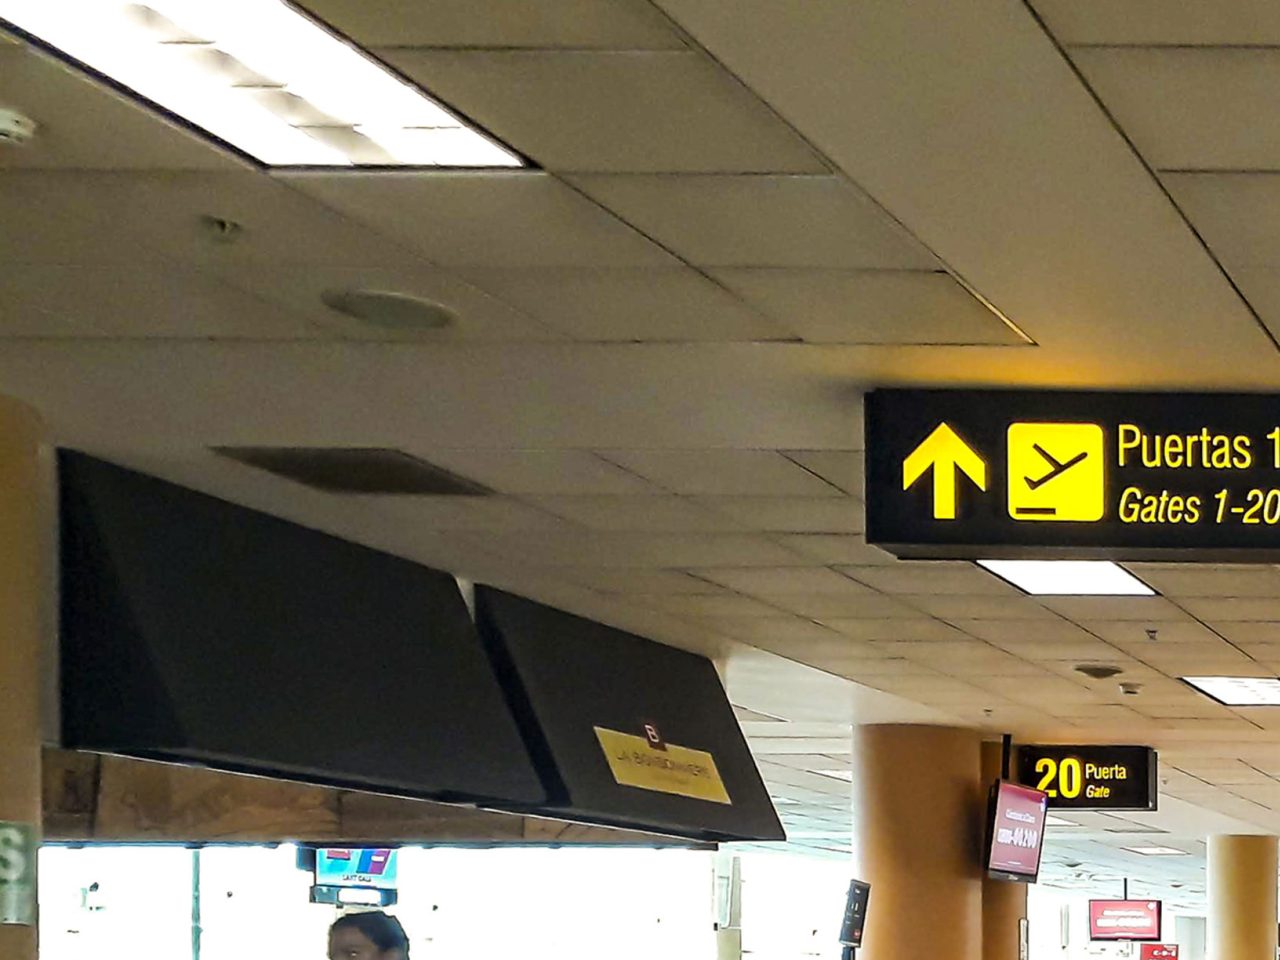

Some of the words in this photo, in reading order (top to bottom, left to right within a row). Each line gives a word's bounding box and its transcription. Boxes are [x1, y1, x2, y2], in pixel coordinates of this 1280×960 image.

[1118, 423, 1252, 469] Puertas
[1118, 486, 1201, 525] Gates
[1035, 757, 1082, 799] 20
[1085, 763, 1127, 780] Puerta
[1085, 784, 1111, 799] Gate
